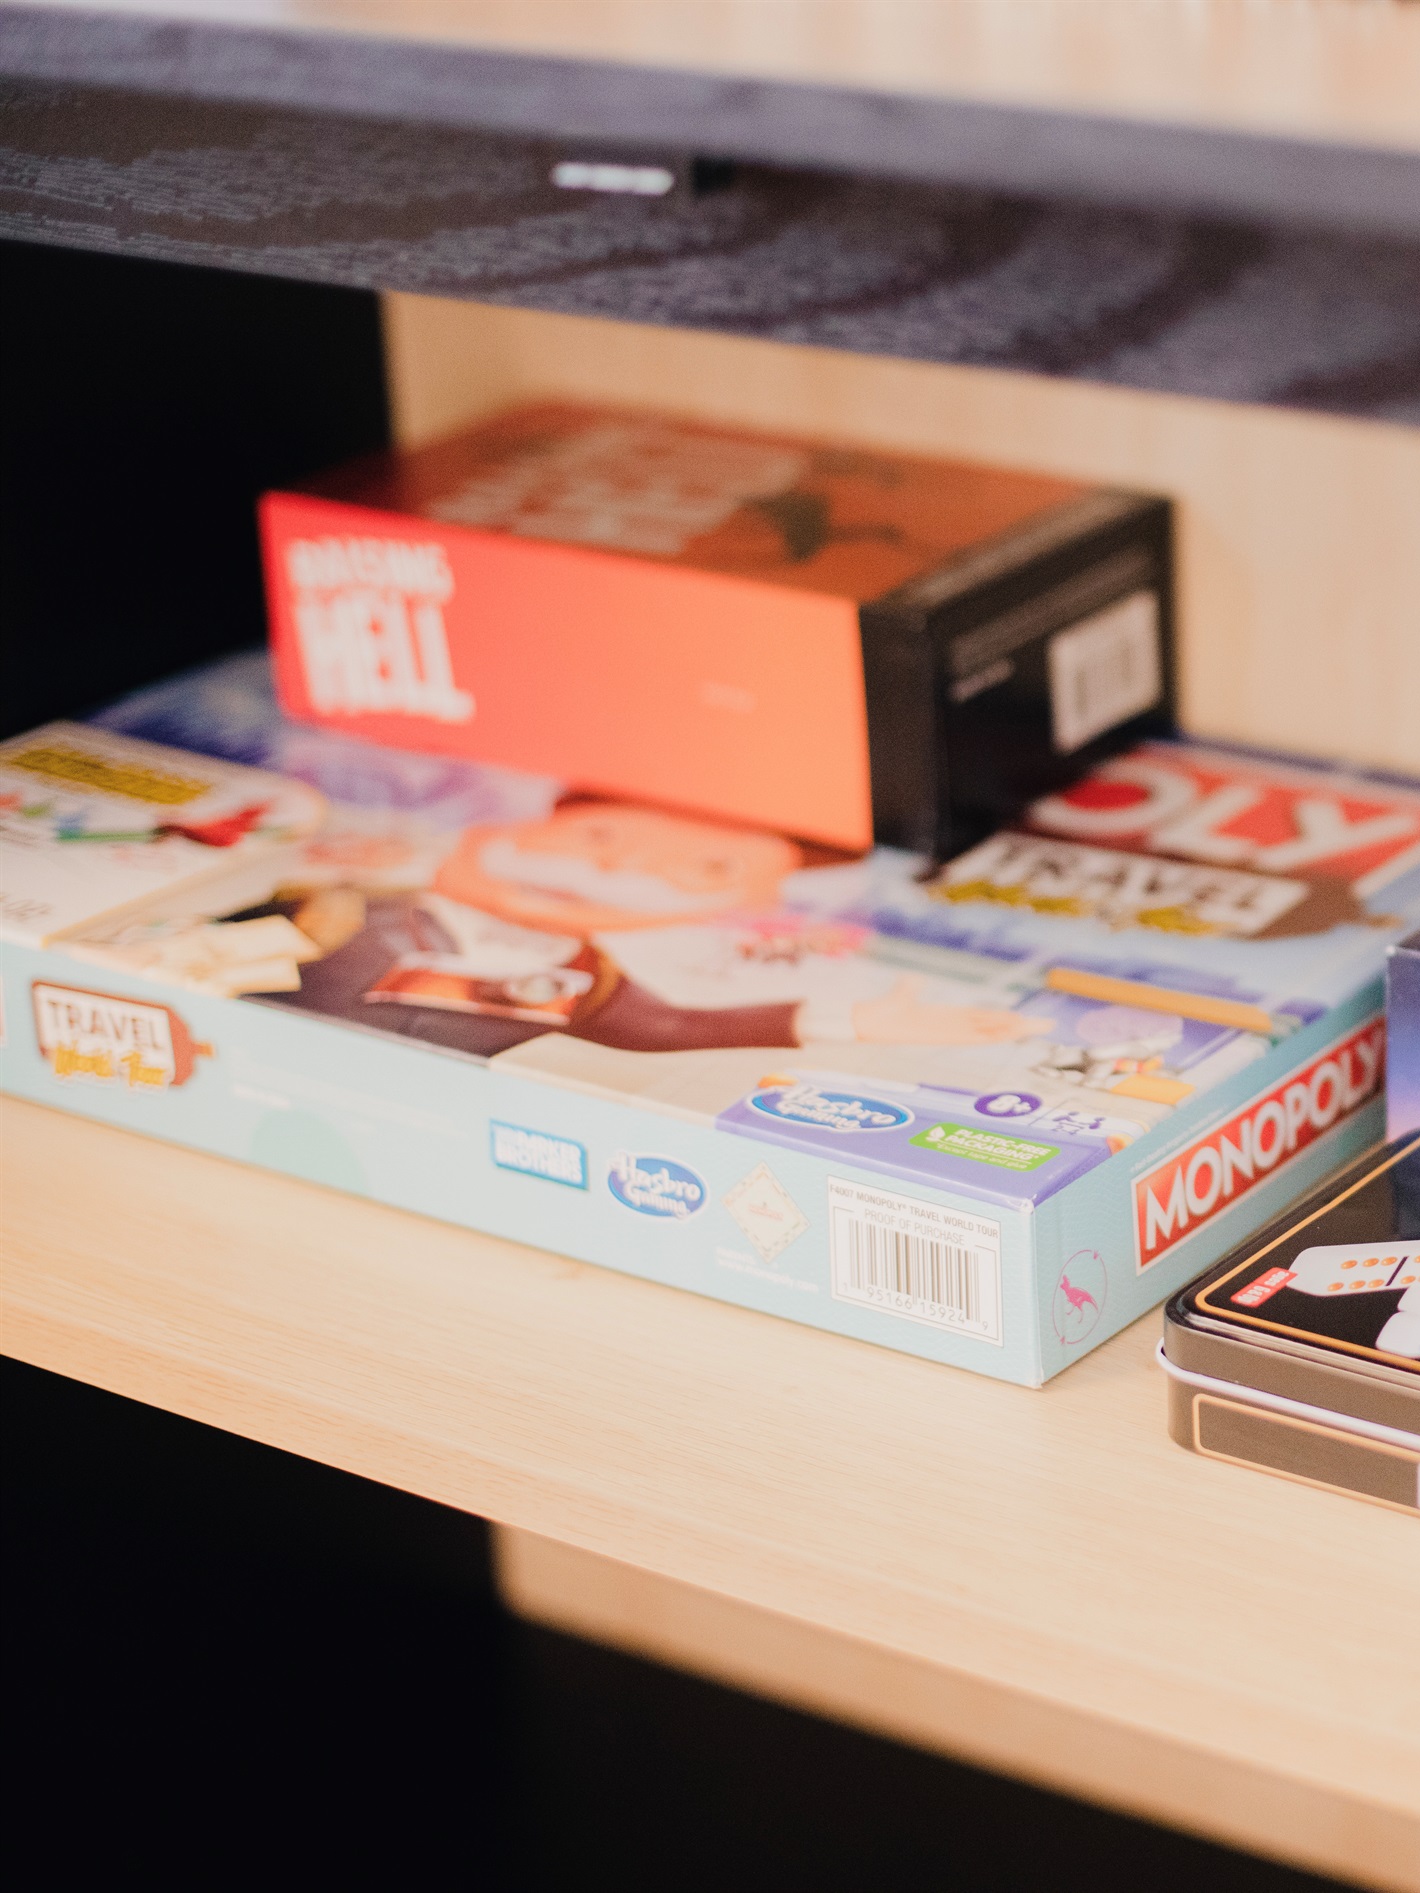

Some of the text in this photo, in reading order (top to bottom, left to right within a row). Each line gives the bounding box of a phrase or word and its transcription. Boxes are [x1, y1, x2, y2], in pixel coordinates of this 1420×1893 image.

[48, 1001, 164, 1050] TRAVEL
[782, 1086, 897, 1127] Hasbro
[954, 1128, 1052, 1157] PLASTIC-FREE
[1145, 1028, 1386, 1251] MONOPOLY
[610, 1151, 702, 1200] Hasbro
[624, 1183, 690, 1219] Gaming
[829, 1183, 855, 1199] F4007
[909, 1205, 942, 1224] TRAVEL
[943, 1214, 974, 1232] WORLD
[976, 1223, 1000, 1239] TOUR
[864, 1208, 966, 1247] PROOF OF PURCHASE
